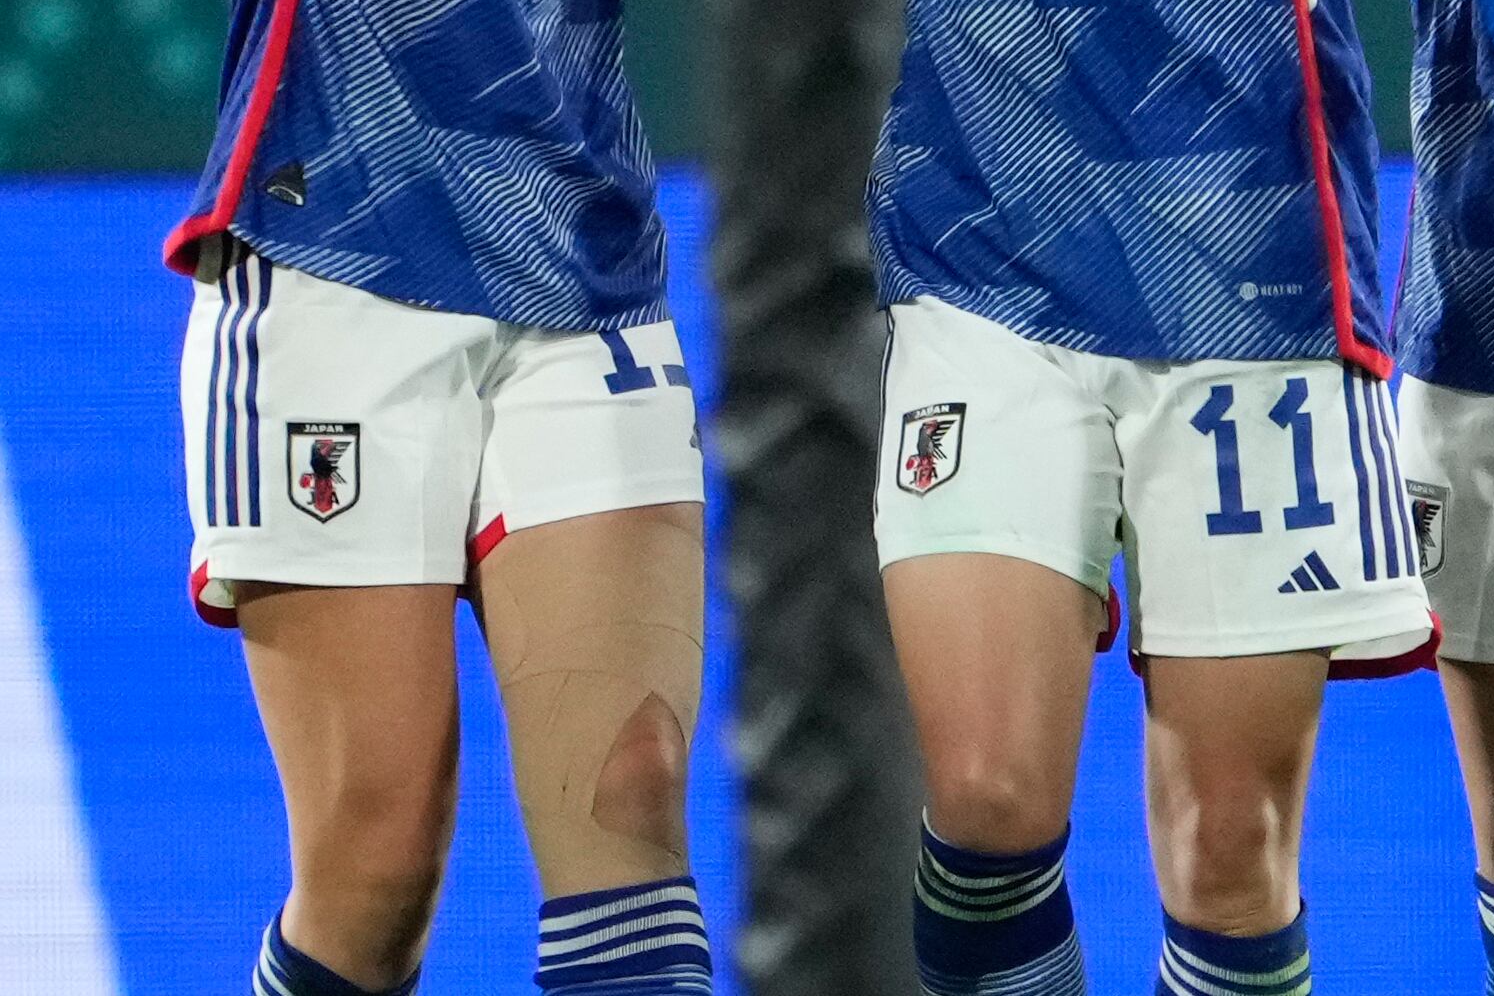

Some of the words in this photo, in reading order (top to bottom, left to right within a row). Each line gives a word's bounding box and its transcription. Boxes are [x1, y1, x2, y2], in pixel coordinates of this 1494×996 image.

[914, 405, 951, 419] JAPAN
[303, 424, 344, 433] JAPAN
[1189, 377, 1336, 536] 11
